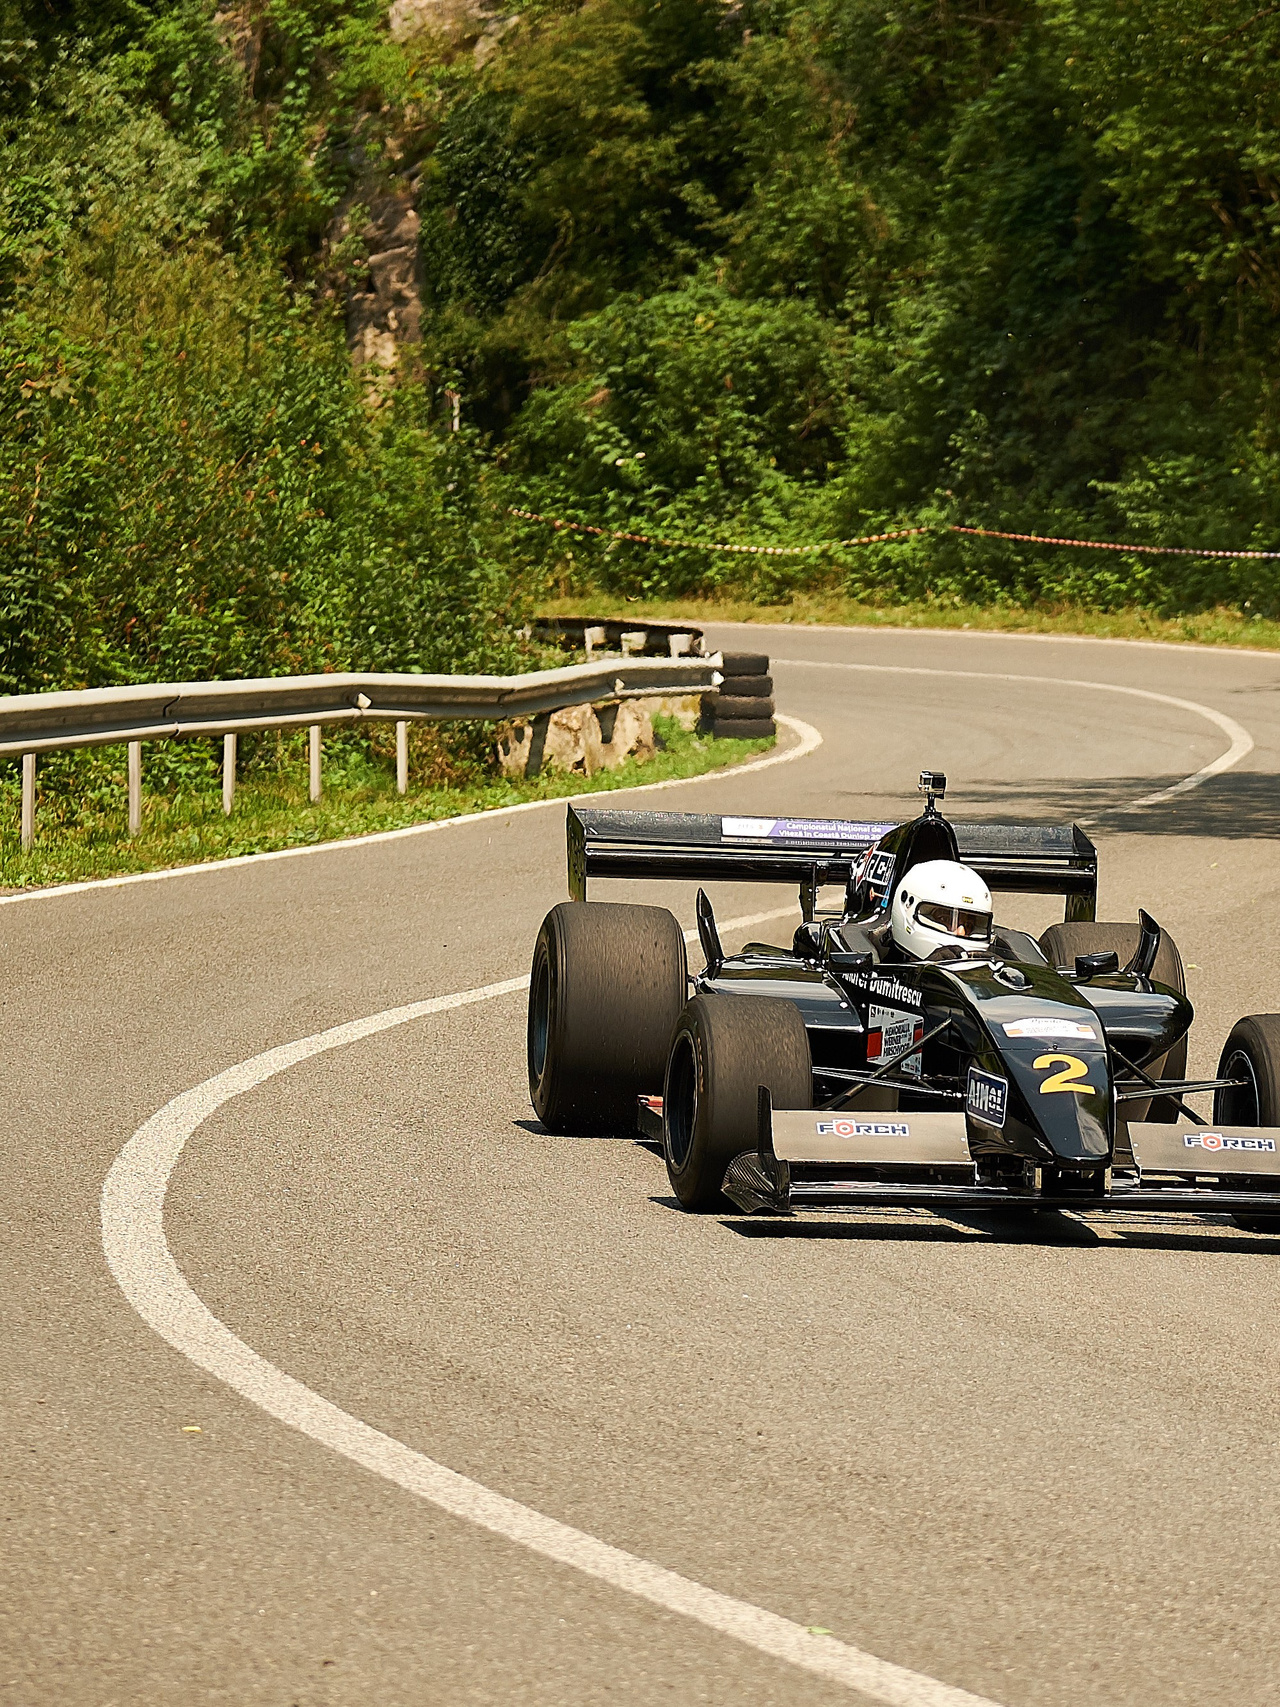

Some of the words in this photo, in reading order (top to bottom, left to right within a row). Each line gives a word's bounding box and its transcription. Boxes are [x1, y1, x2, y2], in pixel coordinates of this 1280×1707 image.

[786, 822, 836, 831] Campionatul
[871, 825, 882, 833] de
[841, 832, 870, 840] Dunlop
[869, 973, 922, 1007] Dumitrescu
[1032, 1053, 1096, 1095] 2
